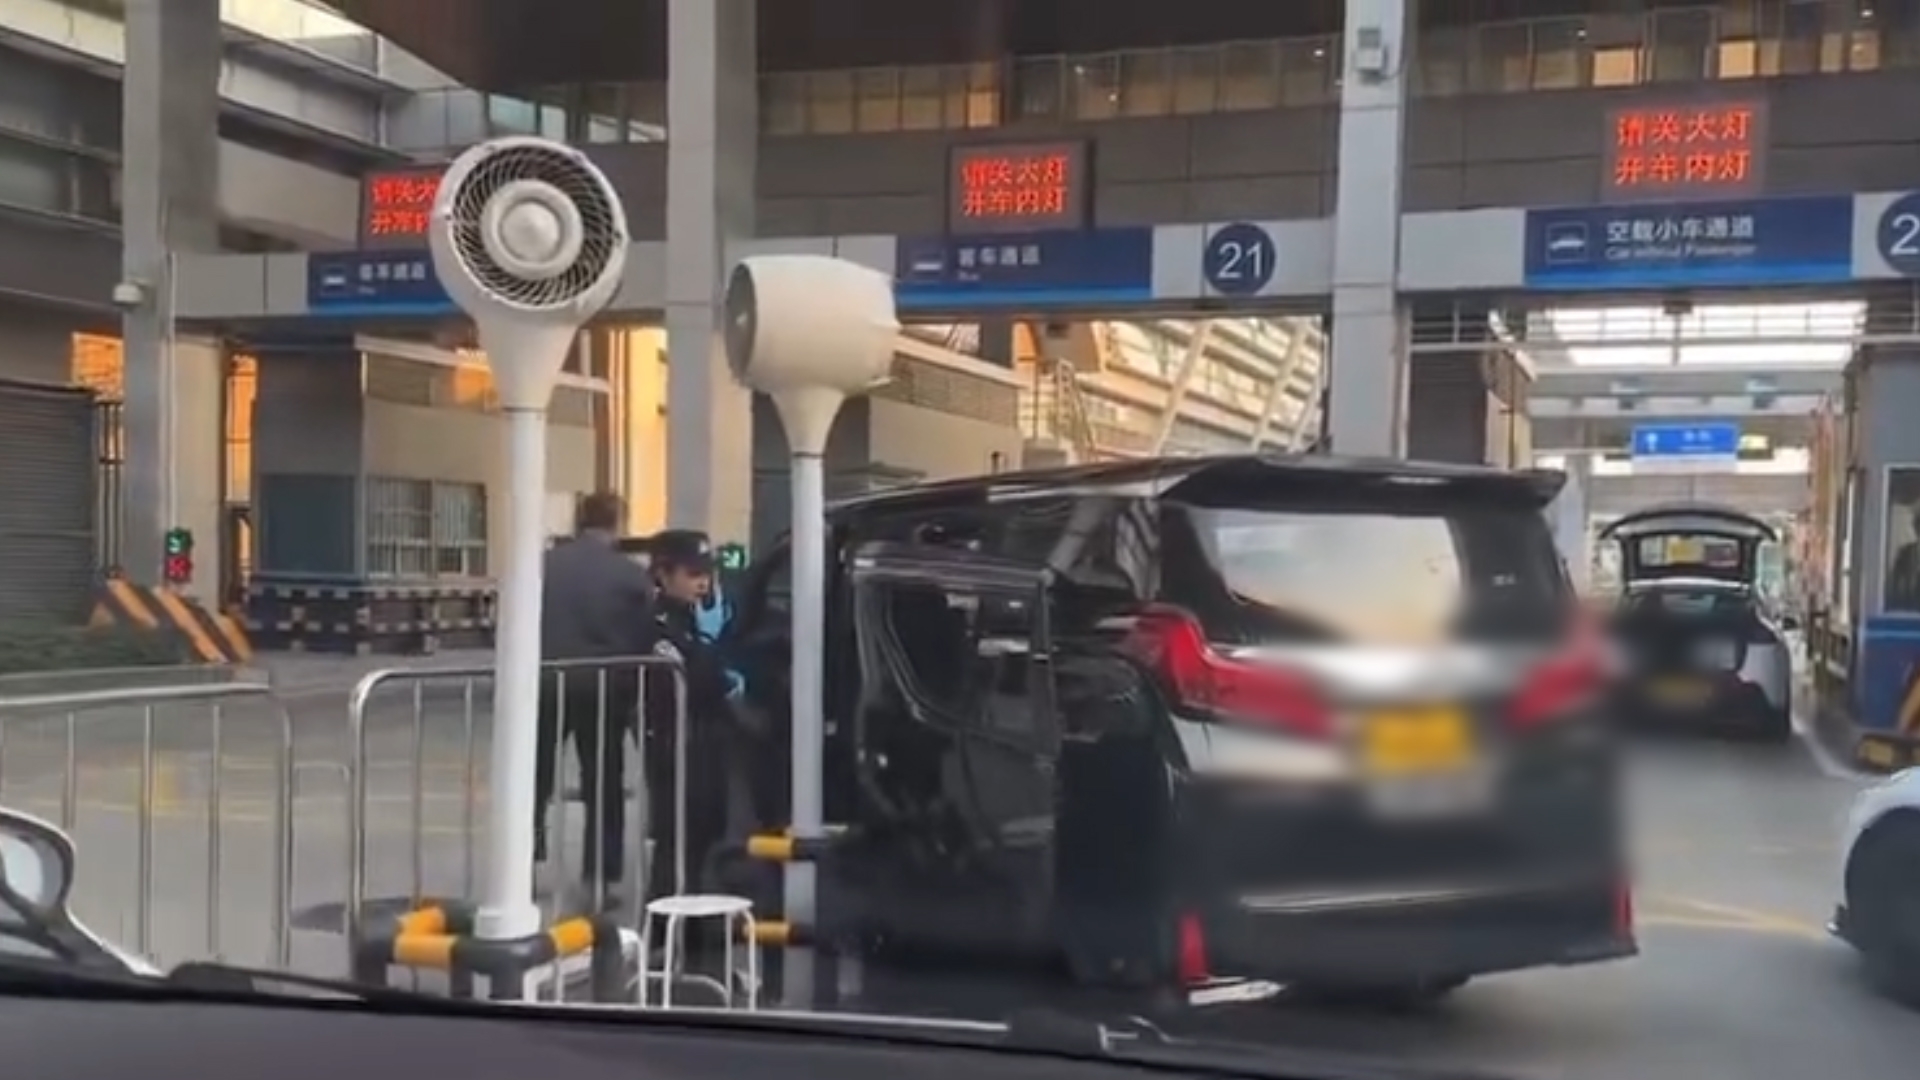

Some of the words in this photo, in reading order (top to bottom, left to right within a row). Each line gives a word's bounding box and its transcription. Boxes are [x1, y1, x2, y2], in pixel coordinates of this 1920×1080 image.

[1615, 150, 1751, 185] 开车内灯
[1889, 213, 1920, 255] 2
[1217, 241, 1263, 279] 21
